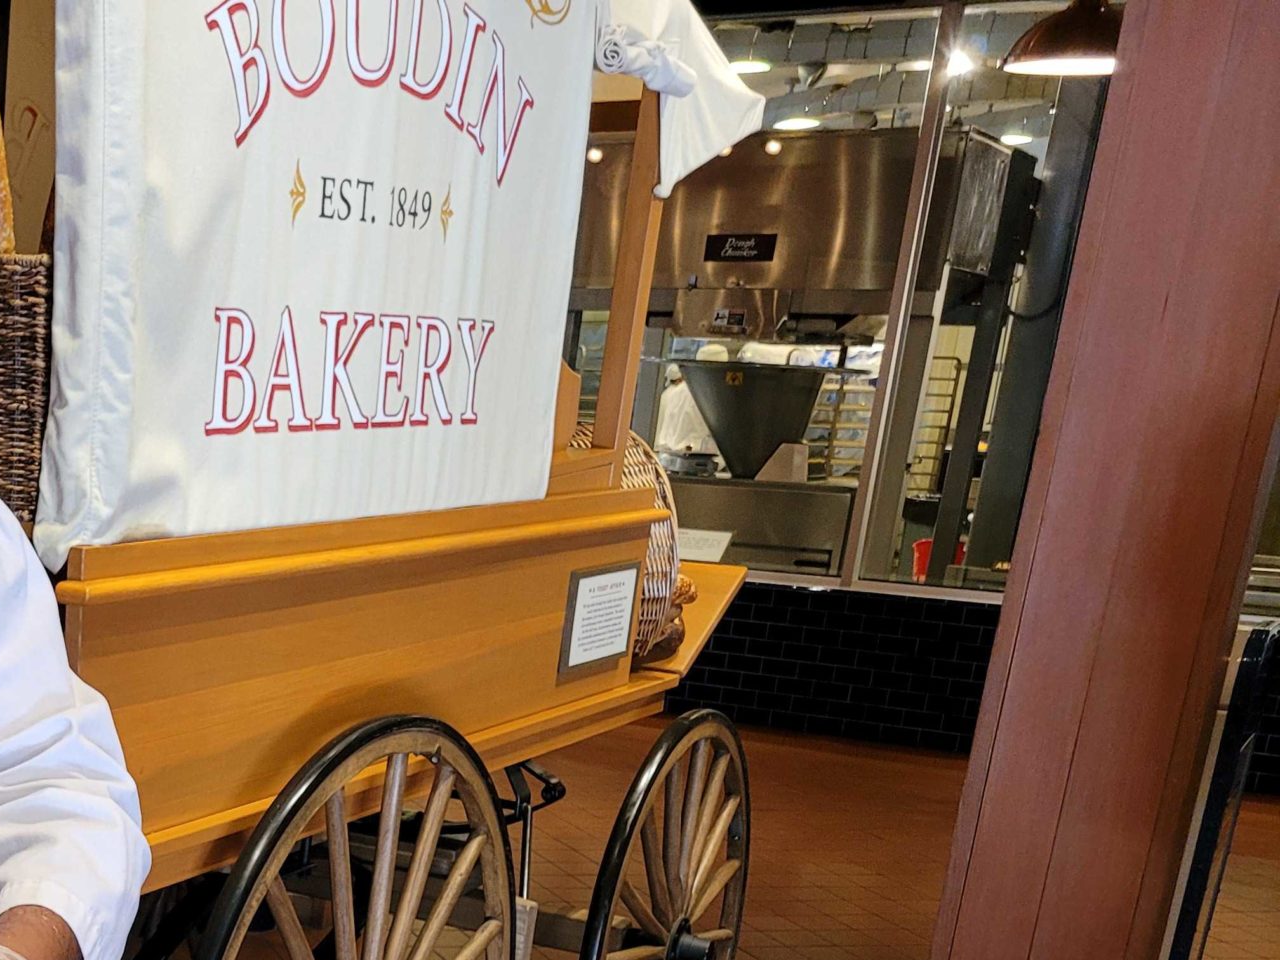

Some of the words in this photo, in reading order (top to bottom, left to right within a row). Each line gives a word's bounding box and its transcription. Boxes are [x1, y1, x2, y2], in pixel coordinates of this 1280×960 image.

[204, 0, 534, 187] BOUDIN
[318, 176, 376, 224] EST.
[388, 186, 432, 230] 1849
[204, 305, 495, 436] BAKERY
